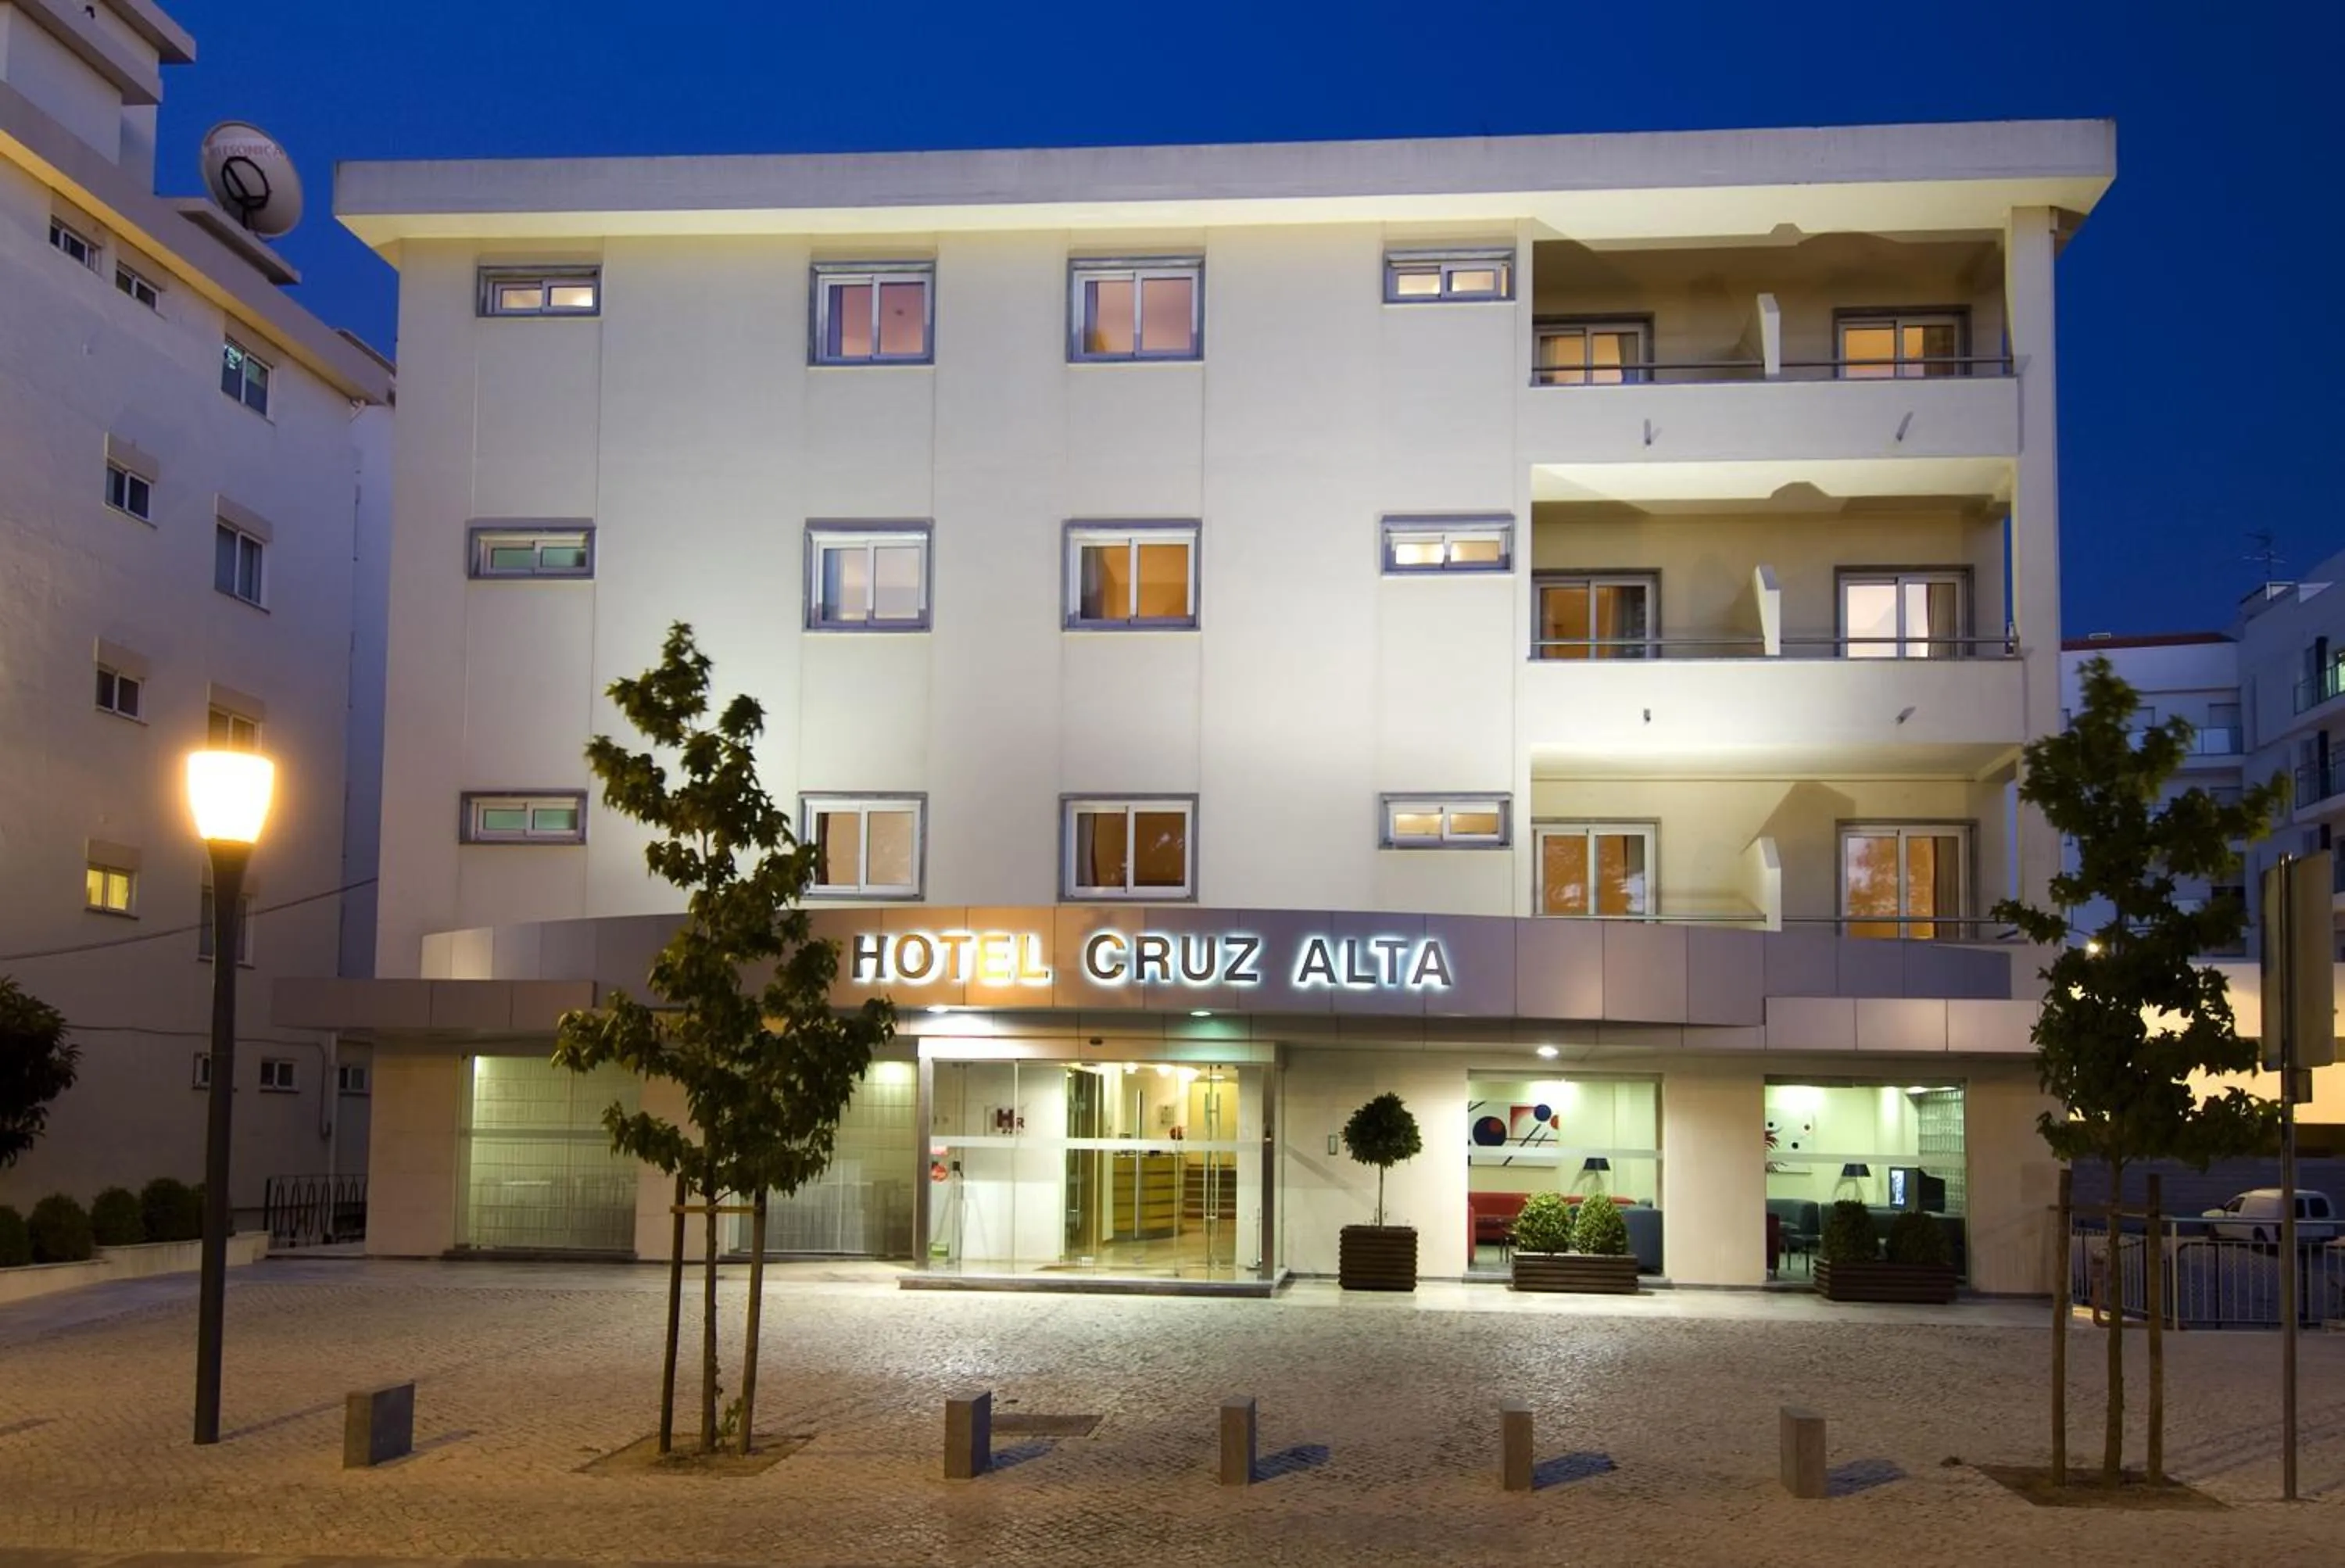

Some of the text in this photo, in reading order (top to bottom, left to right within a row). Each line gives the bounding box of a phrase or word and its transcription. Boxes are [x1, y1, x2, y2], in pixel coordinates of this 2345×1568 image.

[851, 933, 1452, 986] HOTEL CRUZ ALTA
